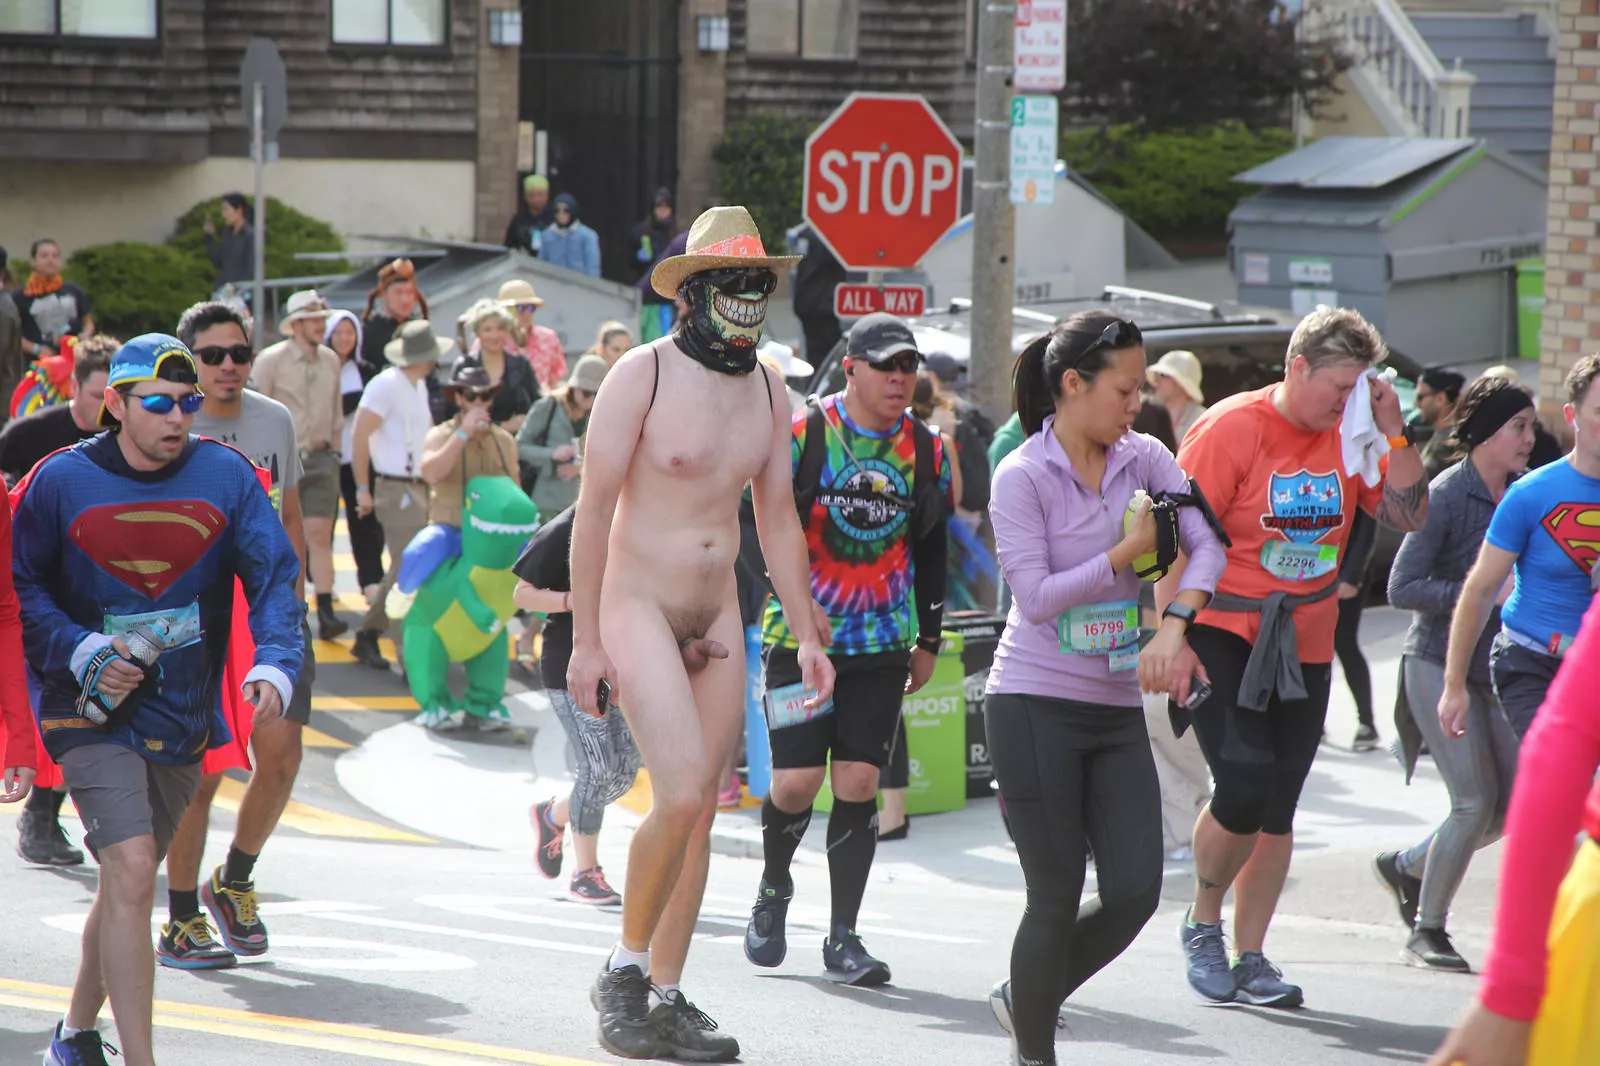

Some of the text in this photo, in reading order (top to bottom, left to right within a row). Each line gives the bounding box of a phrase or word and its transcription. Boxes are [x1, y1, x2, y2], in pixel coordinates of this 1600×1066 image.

[1013, 100, 1023, 124] 2
[816, 149, 954, 217] STOP
[842, 291, 918, 312] ALL WAY
[1277, 557, 1315, 569] 22296
[1084, 619, 1125, 637] 16799
[902, 696, 959, 717] MPOST
